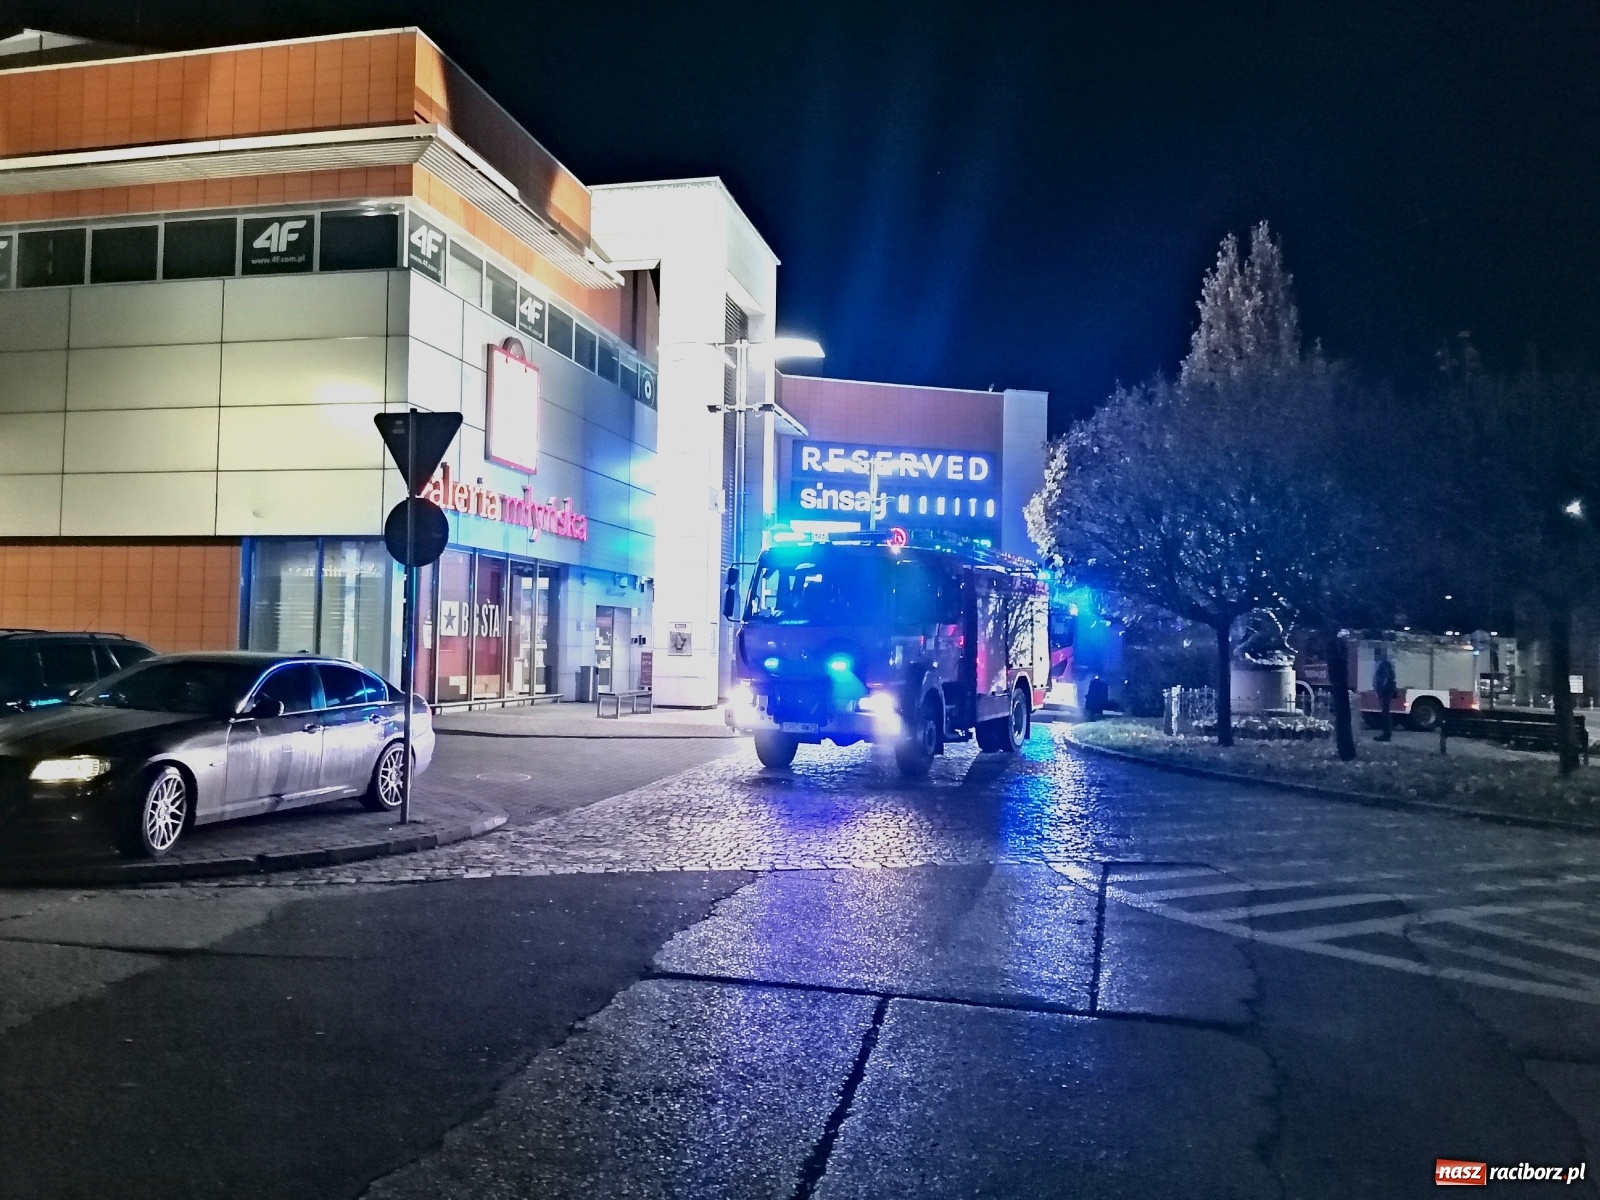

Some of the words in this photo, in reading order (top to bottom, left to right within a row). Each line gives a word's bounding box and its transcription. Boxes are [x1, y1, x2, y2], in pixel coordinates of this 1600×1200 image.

[253, 220, 307, 253] 4F
[410, 225, 443, 259] 4F
[520, 297, 544, 325] 4F
[802, 446, 989, 481] RESERVED
[416, 463, 502, 522] aleria
[800, 482, 887, 520] sinsay
